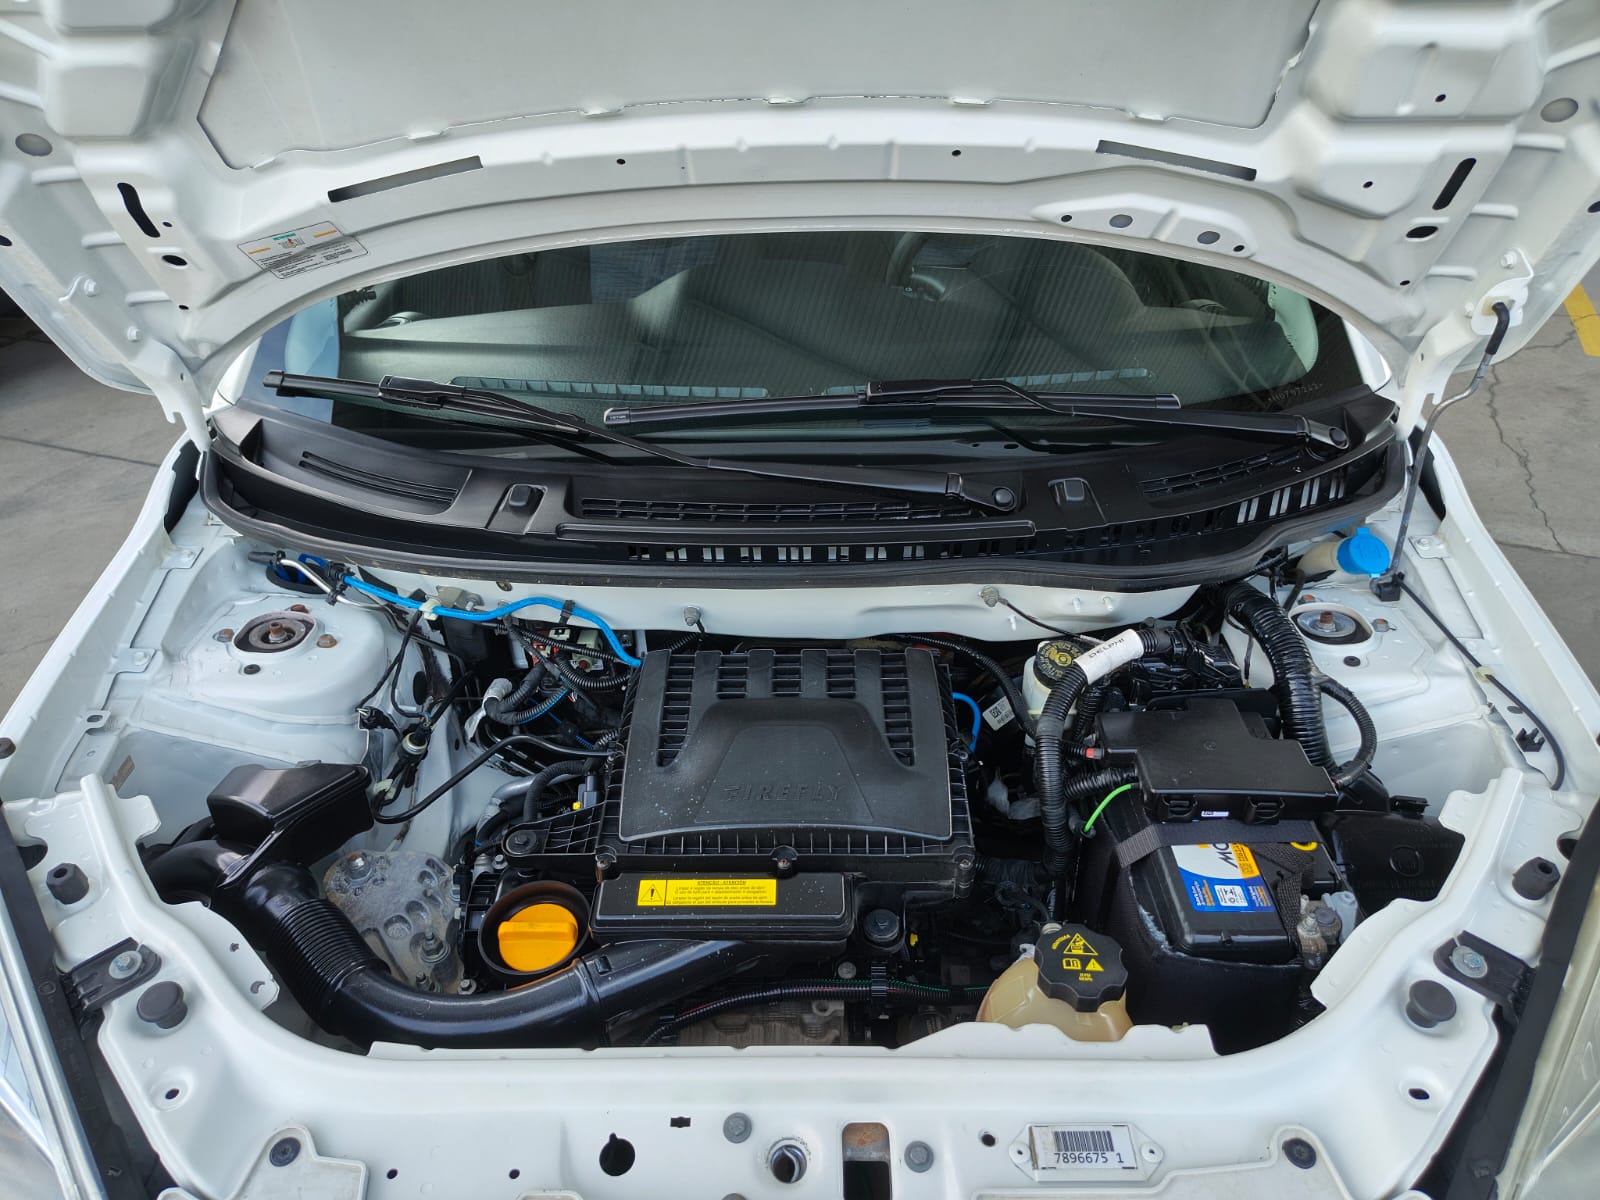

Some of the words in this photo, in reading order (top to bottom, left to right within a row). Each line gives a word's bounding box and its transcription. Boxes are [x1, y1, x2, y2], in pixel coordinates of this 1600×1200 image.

[1089, 638, 1124, 658] DELPHI
[721, 784, 847, 800] FIREFLY
[1054, 1152, 1109, 1164] 7896675
[1116, 1152, 1124, 1164] 1
